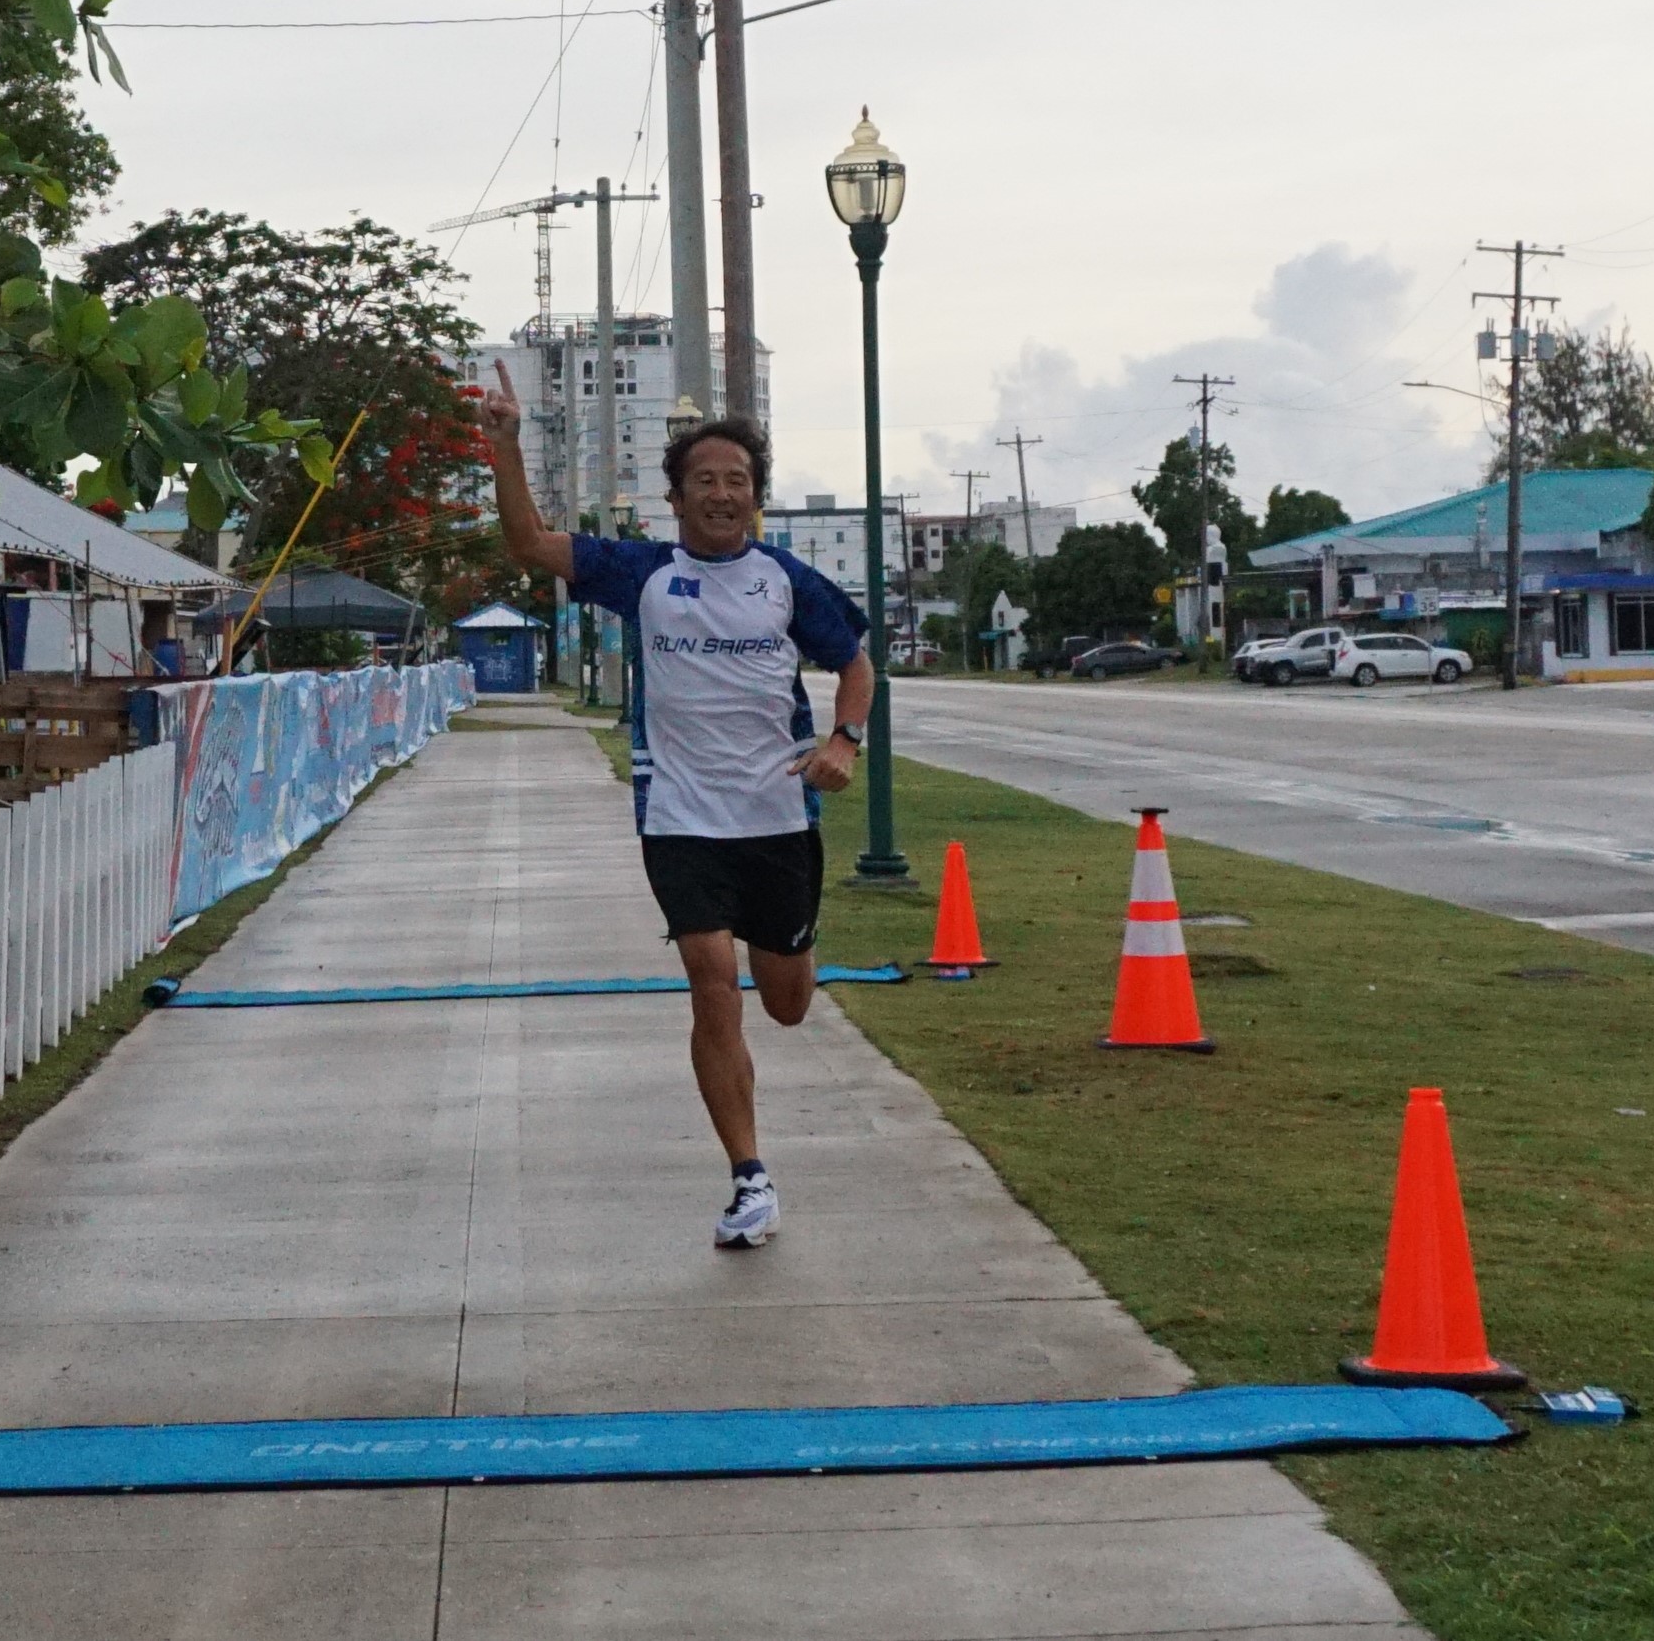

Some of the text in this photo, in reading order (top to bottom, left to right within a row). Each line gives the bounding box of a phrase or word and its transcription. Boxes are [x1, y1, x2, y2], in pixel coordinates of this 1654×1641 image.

[1420, 602, 1436, 613] 35
[652, 635, 784, 655] RUN SAIPAN
